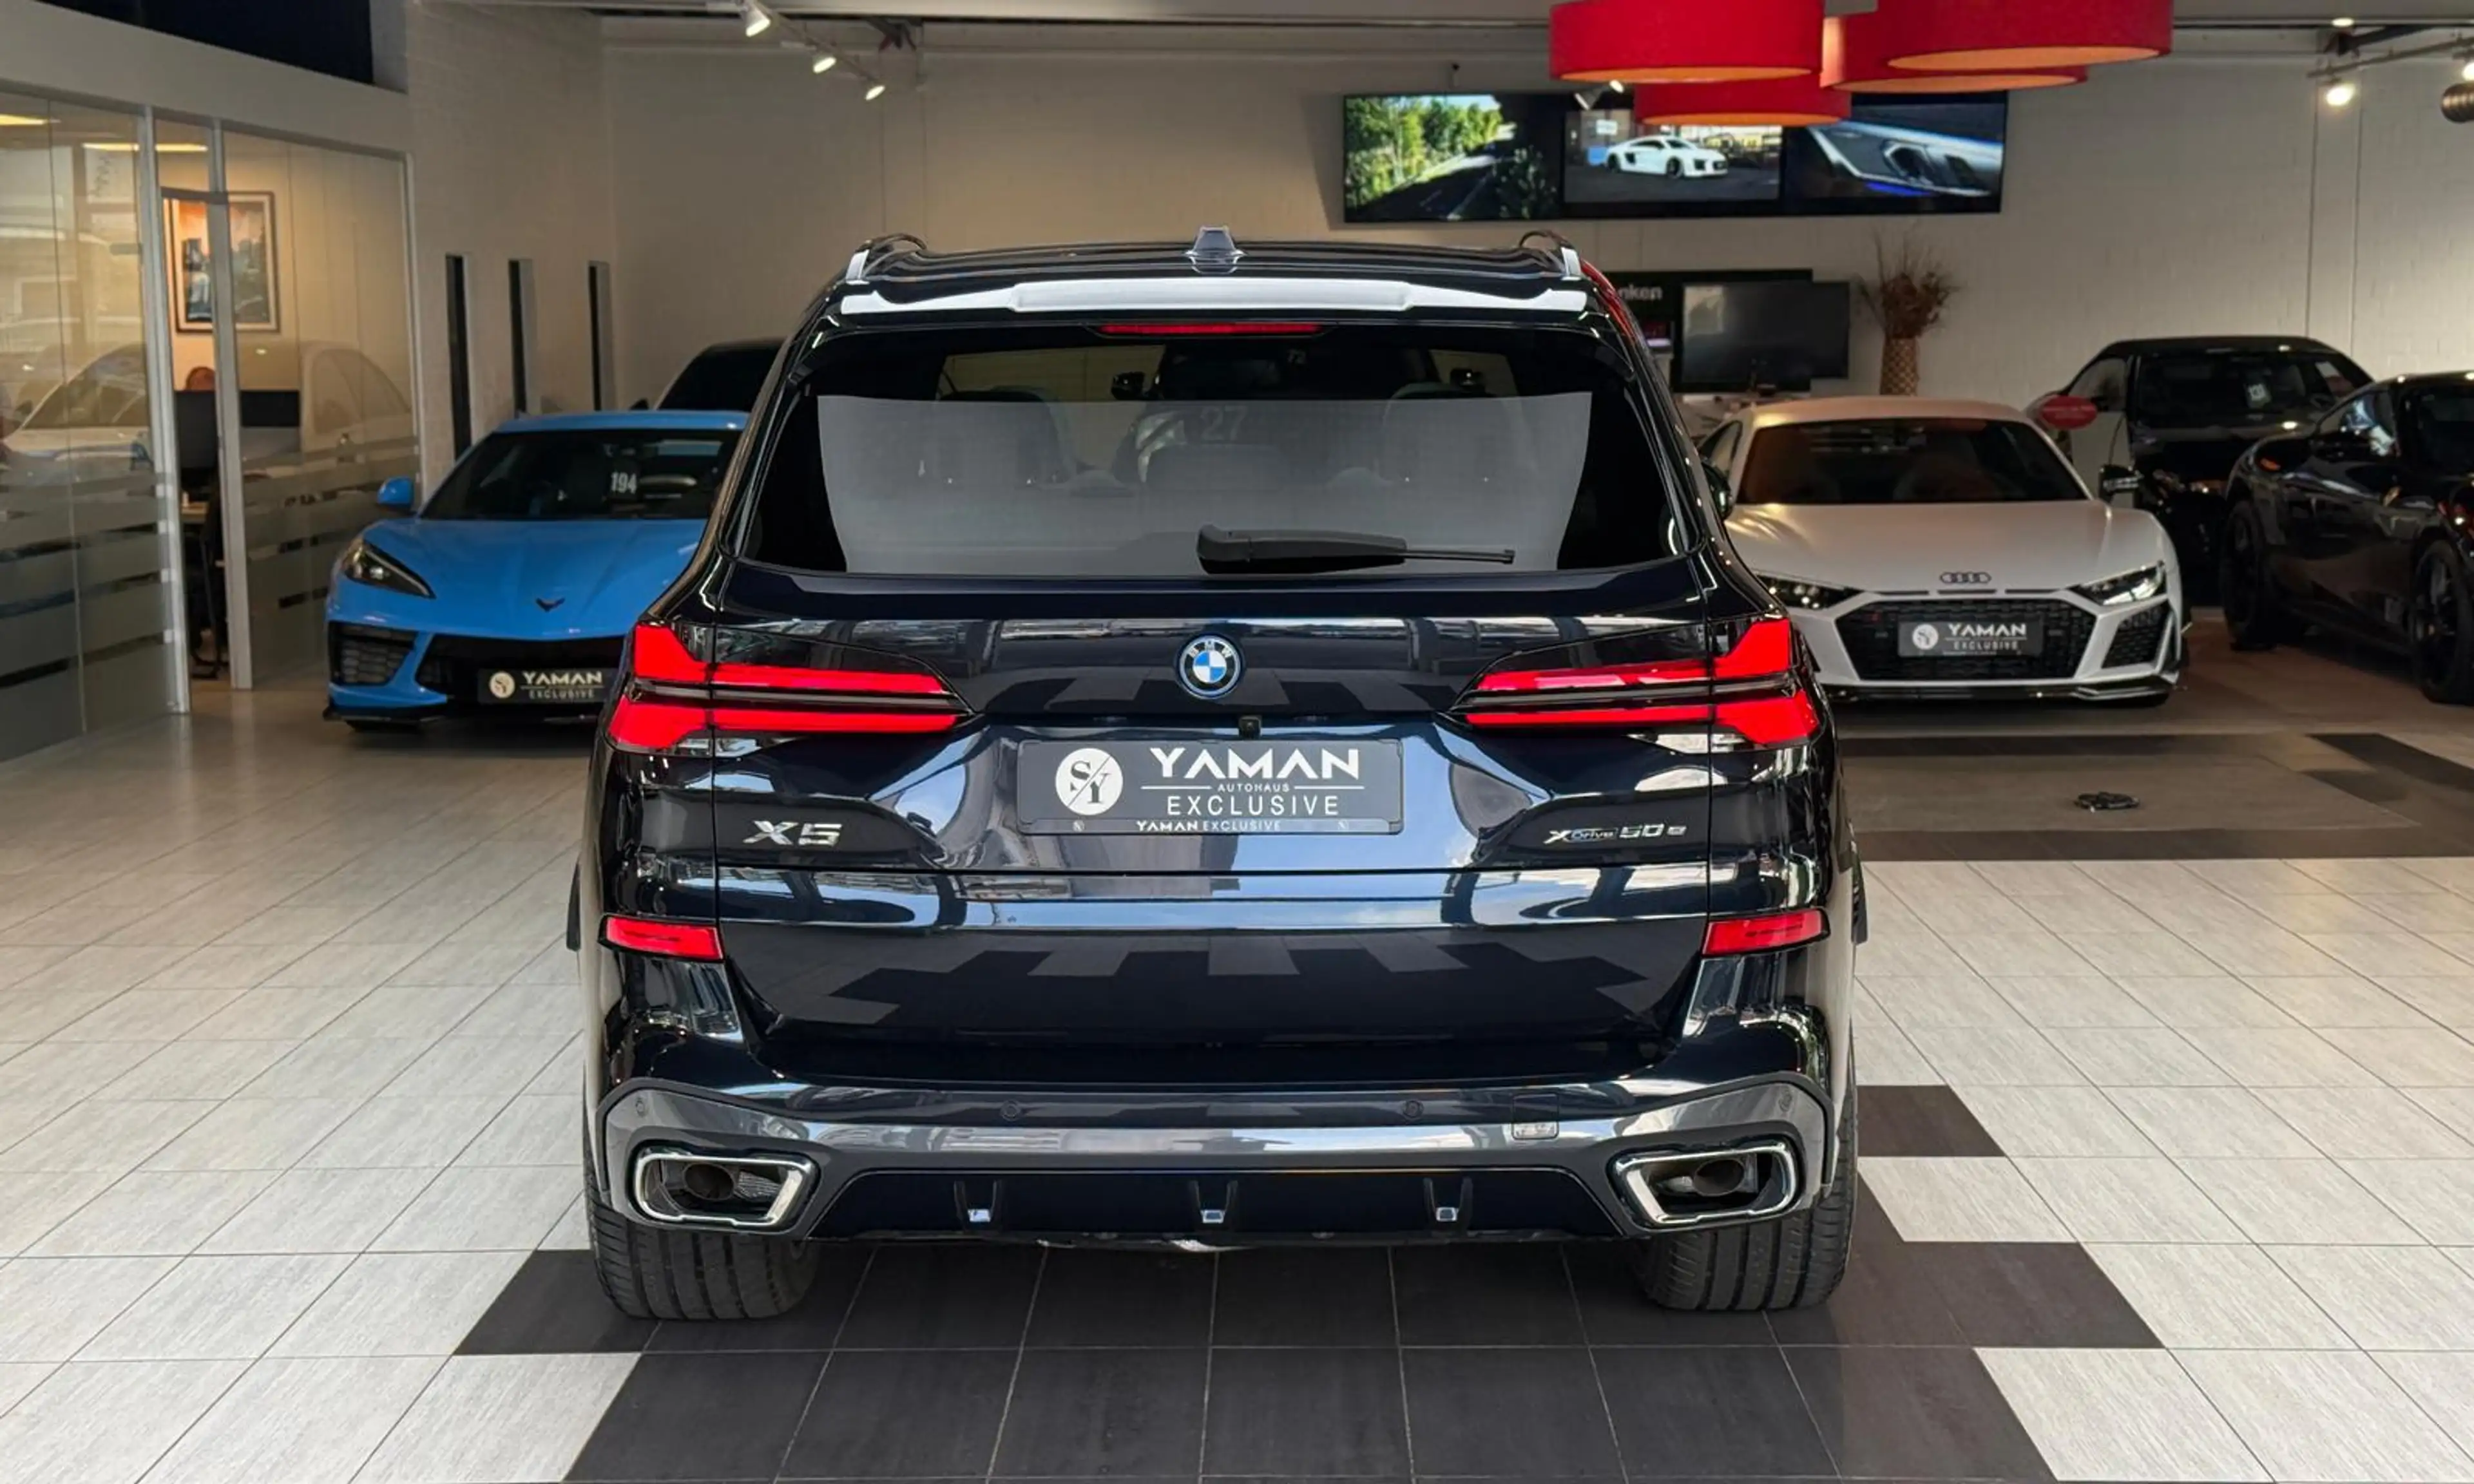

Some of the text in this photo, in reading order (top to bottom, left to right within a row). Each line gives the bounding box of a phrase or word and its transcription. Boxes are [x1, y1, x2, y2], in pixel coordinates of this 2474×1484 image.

[1618, 283, 1664, 300] nken
[1948, 622, 2027, 636] YAMAN
[1953, 640, 2018, 651] EXCLUSIVE
[522, 670, 602, 685] YAMAN
[528, 689, 595, 699] EXCLUSIVE
[1149, 747, 1359, 780] YAMAN
[1217, 783, 1290, 792] AUTOHAUS
[1167, 794, 1339, 816] EXCLUSIVE
[1136, 820, 1282, 832] YAMAN EXCLUSIVE
[742, 820, 843, 848] X5
